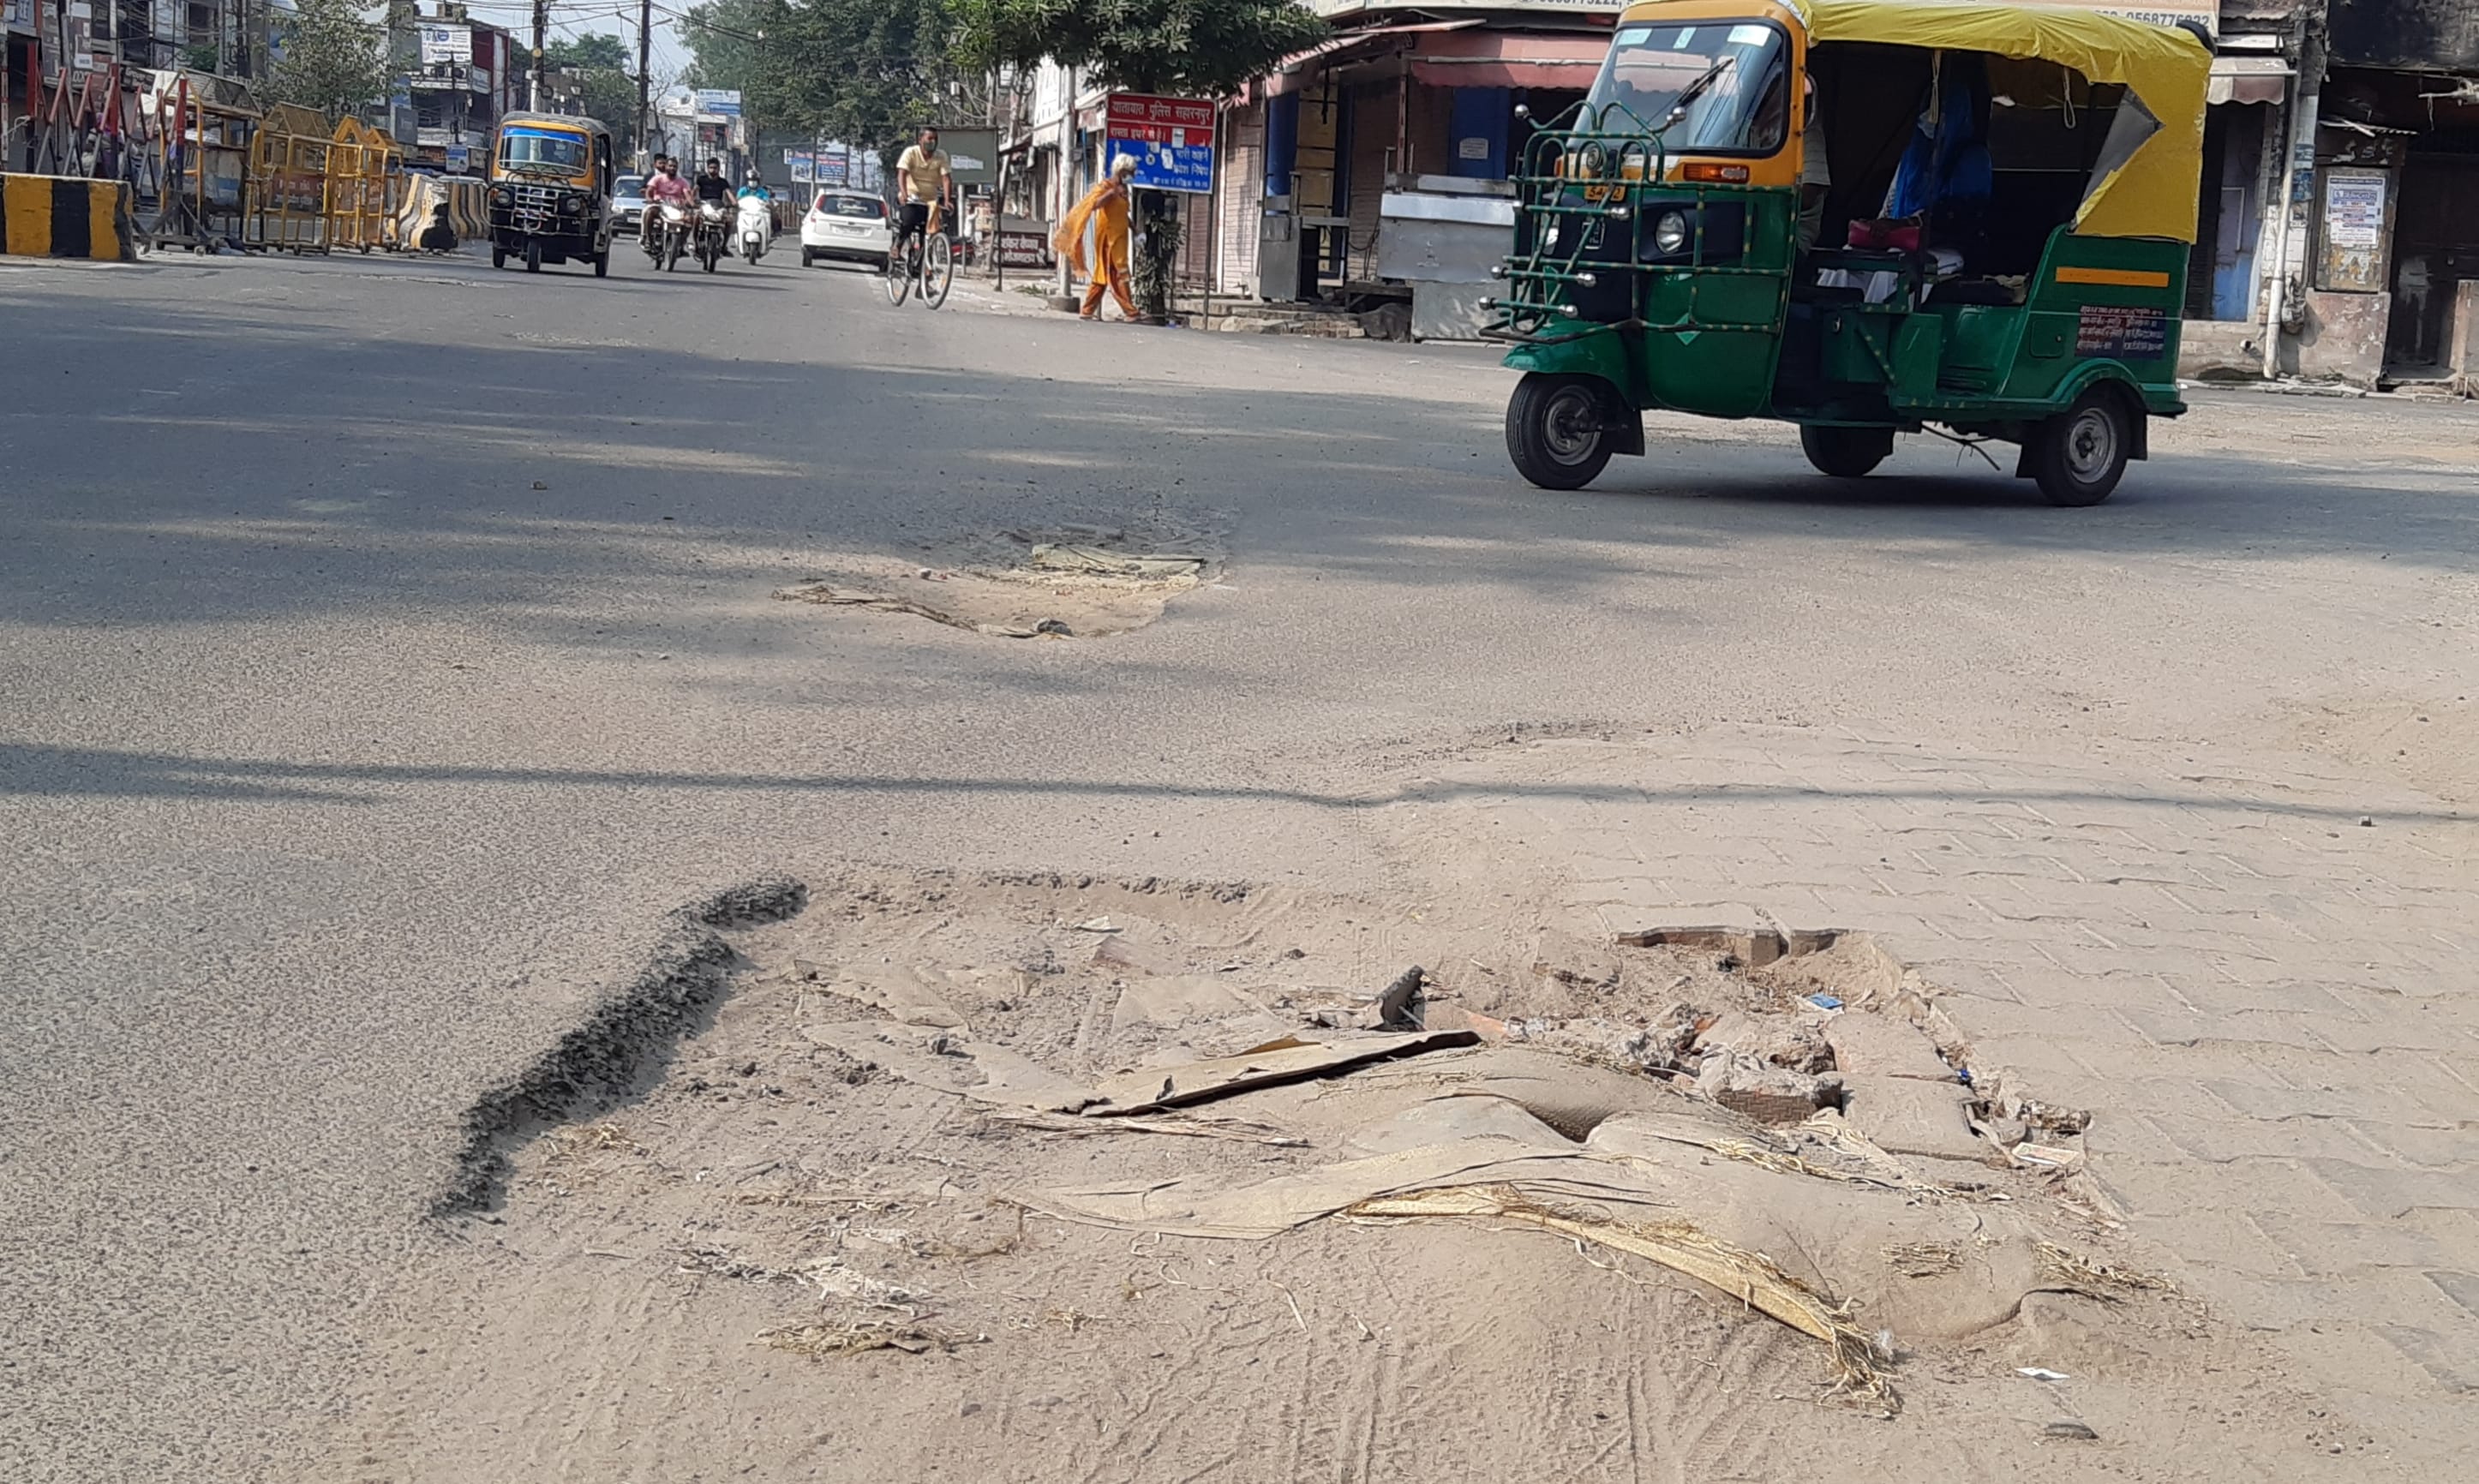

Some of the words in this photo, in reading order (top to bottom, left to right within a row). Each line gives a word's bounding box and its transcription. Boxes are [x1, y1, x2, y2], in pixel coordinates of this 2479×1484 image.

[1111, 101, 1145, 116] यातायात
[1149, 100, 1171, 121] पुलिस
[1175, 105, 1211, 125] सहारनपुर
